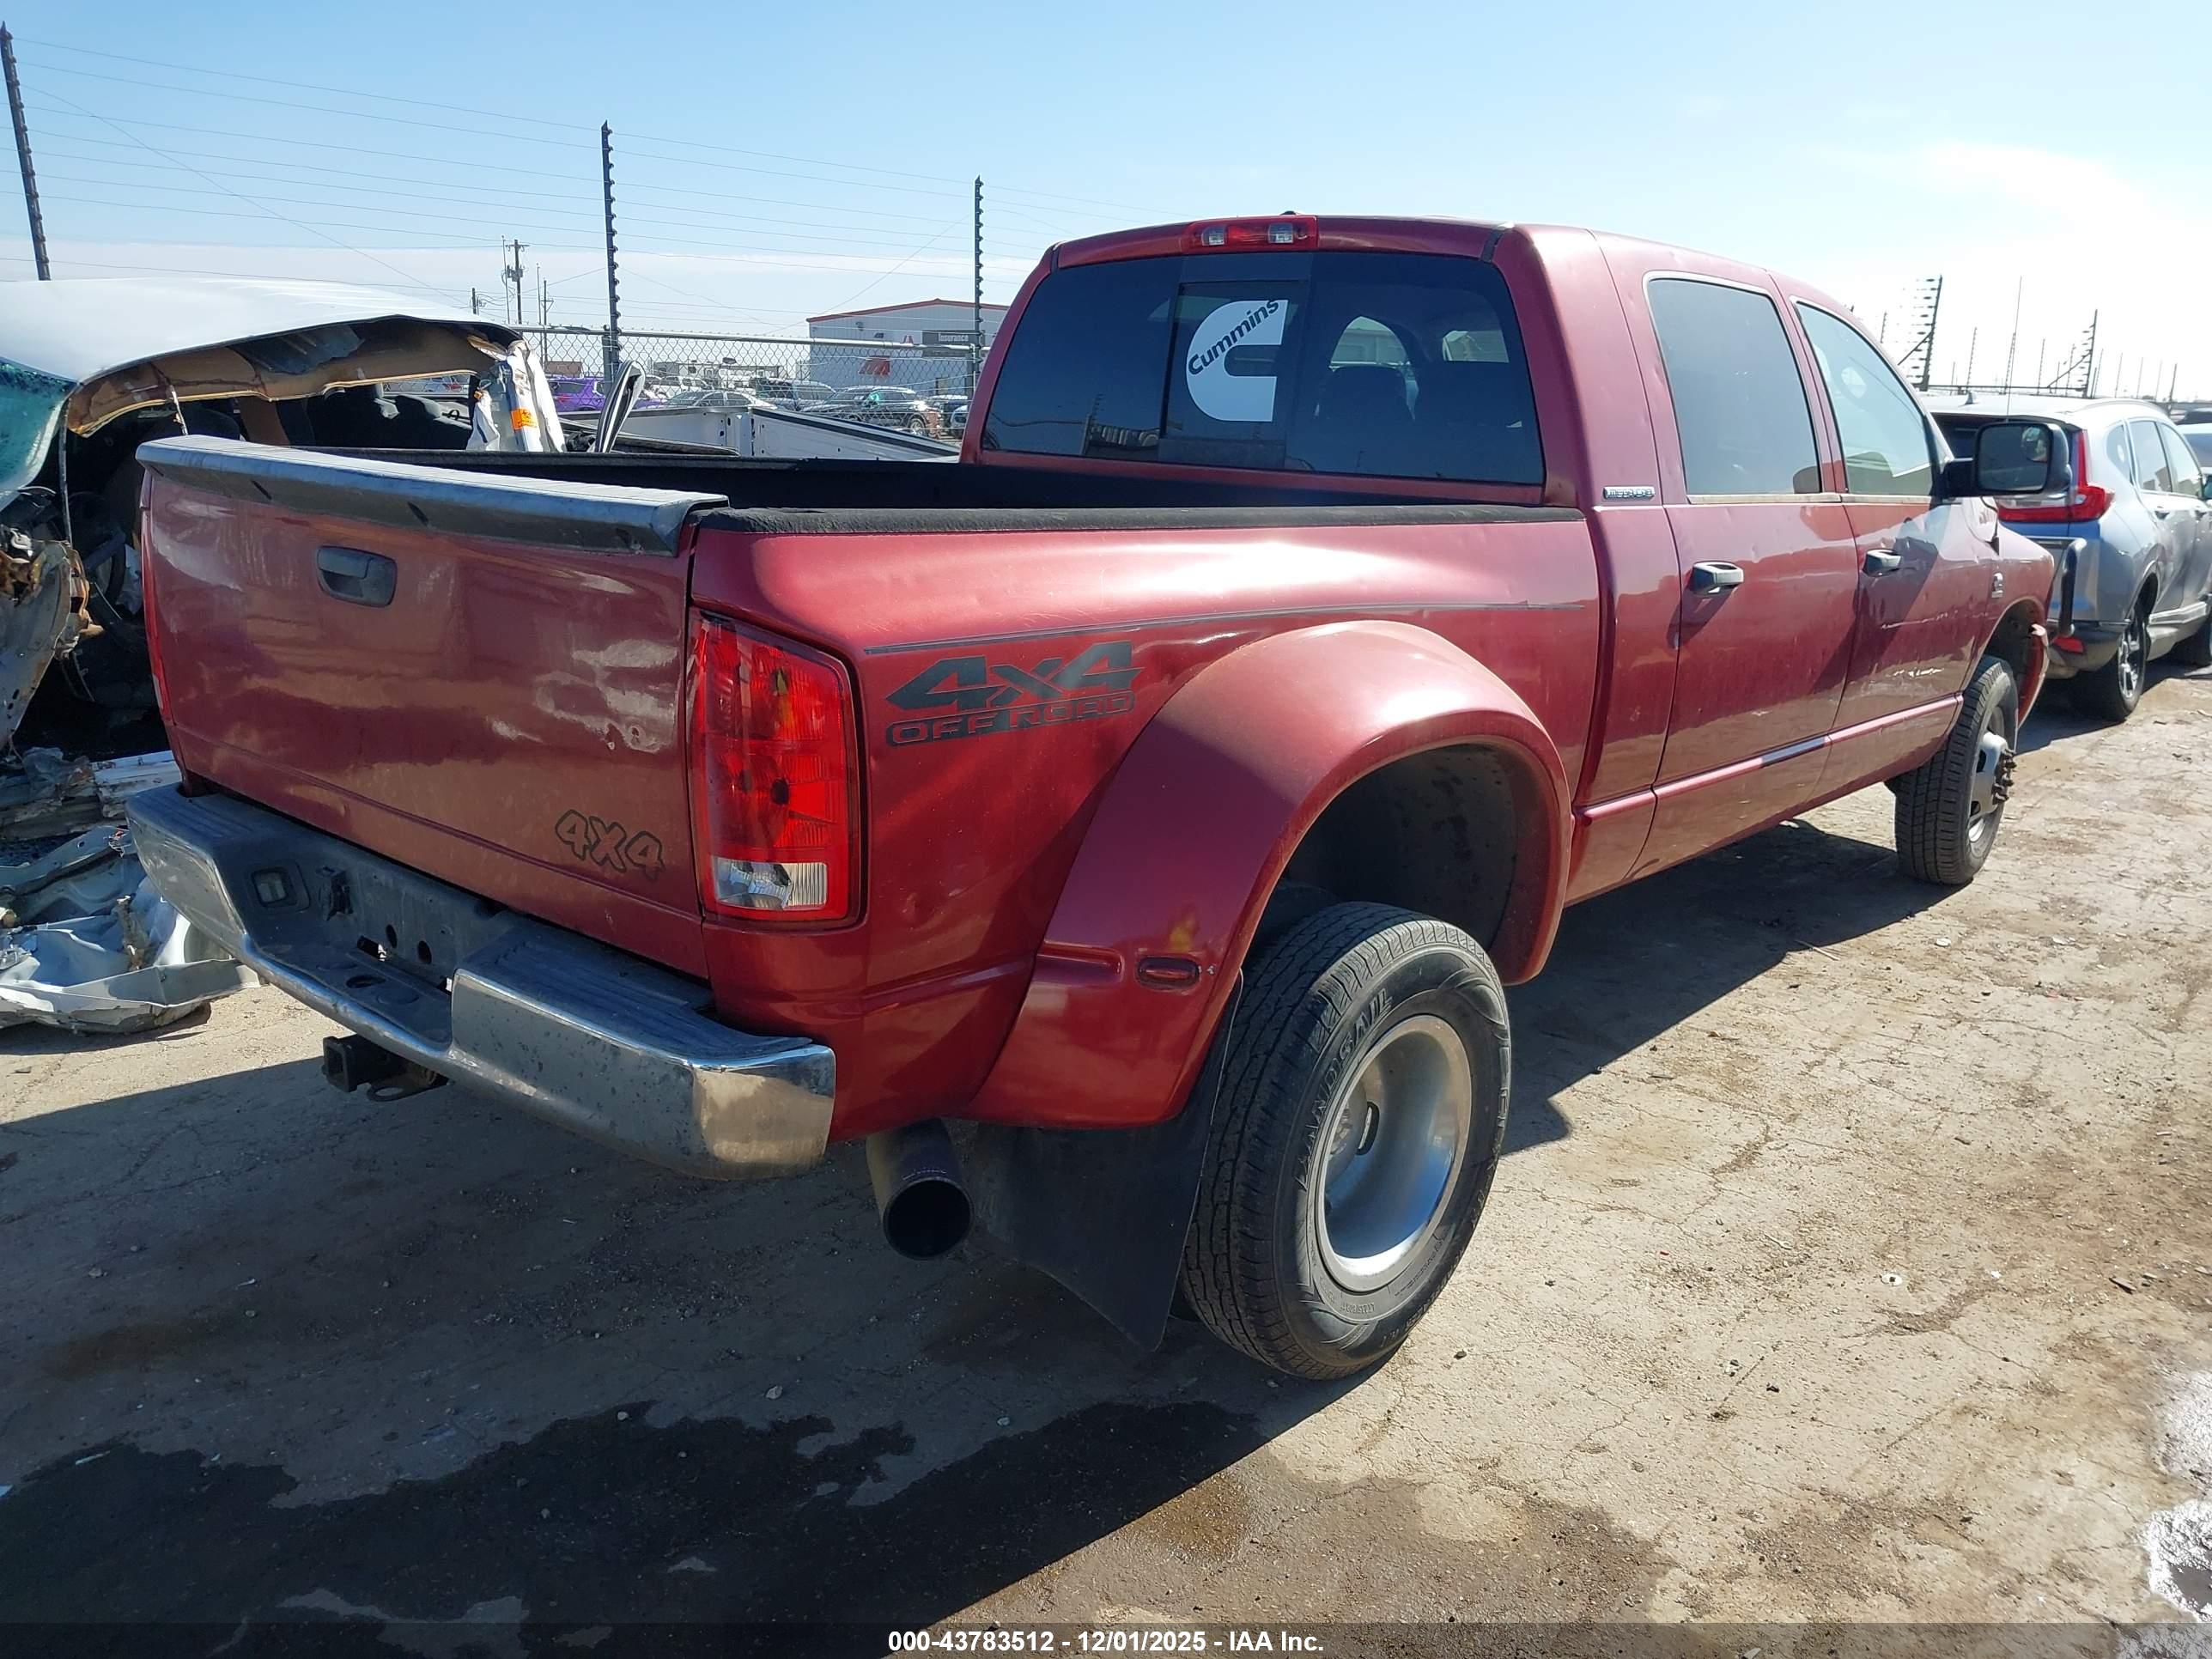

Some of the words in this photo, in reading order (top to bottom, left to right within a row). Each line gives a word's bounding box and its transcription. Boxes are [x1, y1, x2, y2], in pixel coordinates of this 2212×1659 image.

[1188, 300, 1279, 375] Cummins
[890, 712, 999, 744] OFF
[1009, 692, 1134, 728] ROAD
